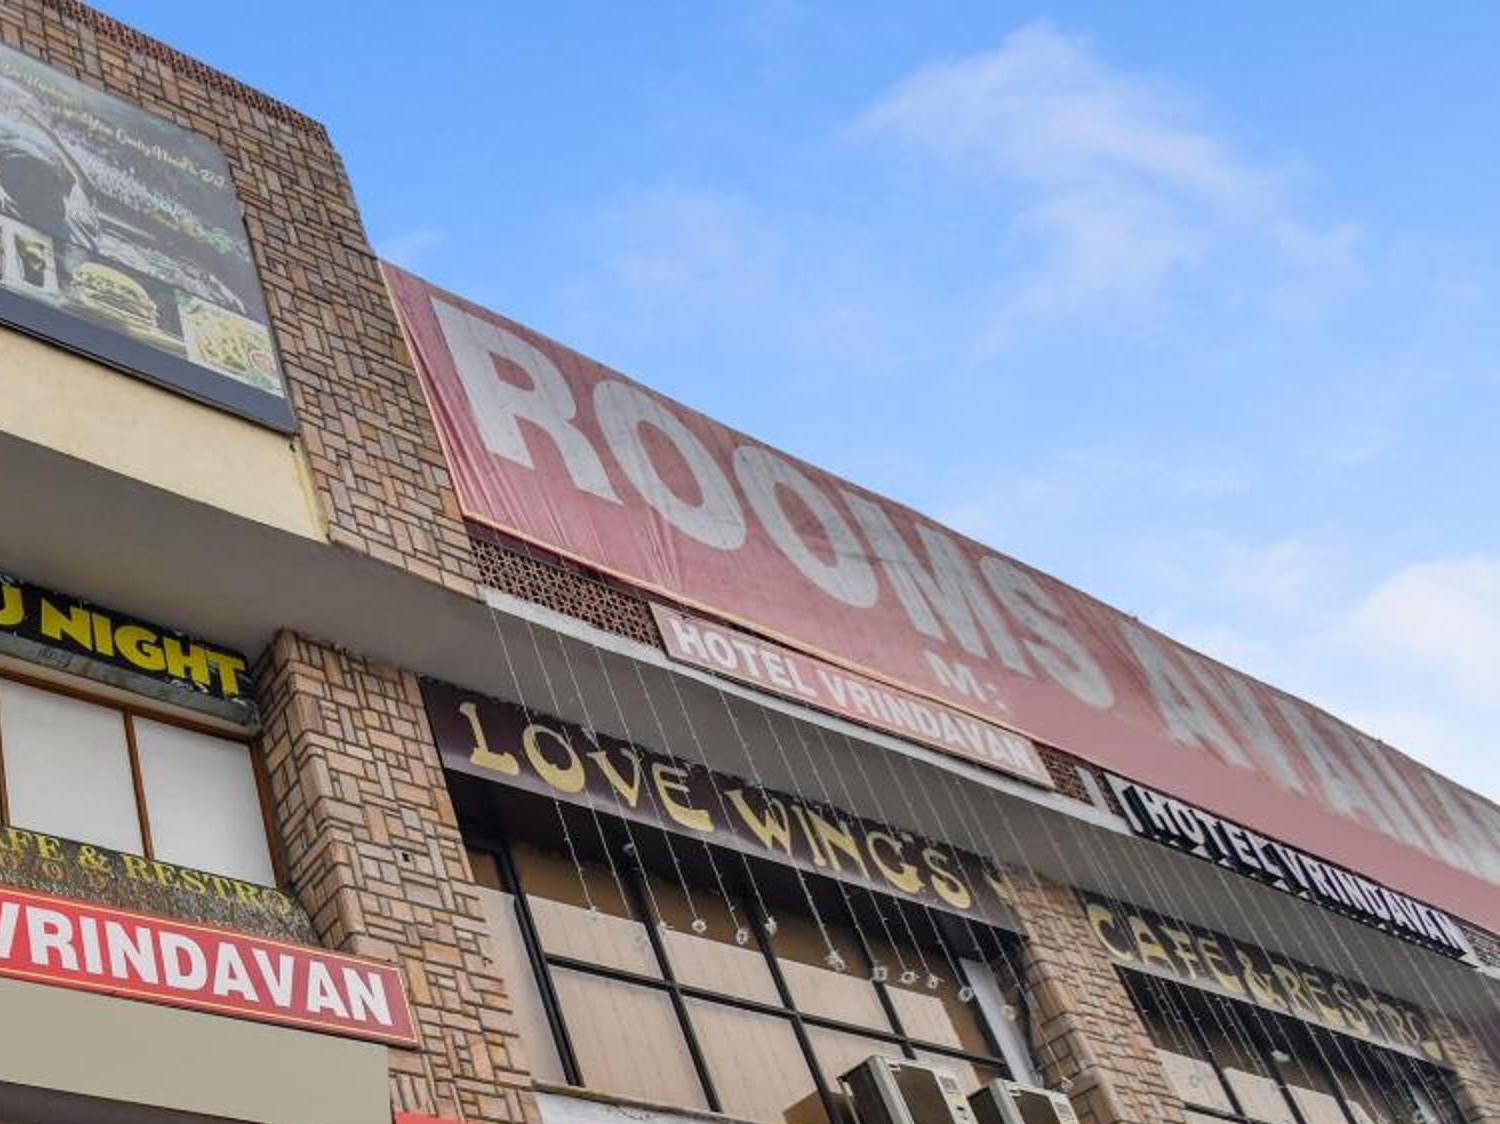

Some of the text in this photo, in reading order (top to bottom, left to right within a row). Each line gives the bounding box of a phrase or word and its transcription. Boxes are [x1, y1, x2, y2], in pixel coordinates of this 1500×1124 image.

[430, 295, 1115, 711] ROOMS
[41, 597, 246, 698] NIGHT
[669, 616, 1035, 772] HOTEL VRINDAVAN
[76, 844, 114, 871] &
[459, 702, 972, 909] LOVE WINGS
[1143, 790, 1469, 956] HOTEL VRINDAVAN
[1087, 902, 1244, 994] CAFE
